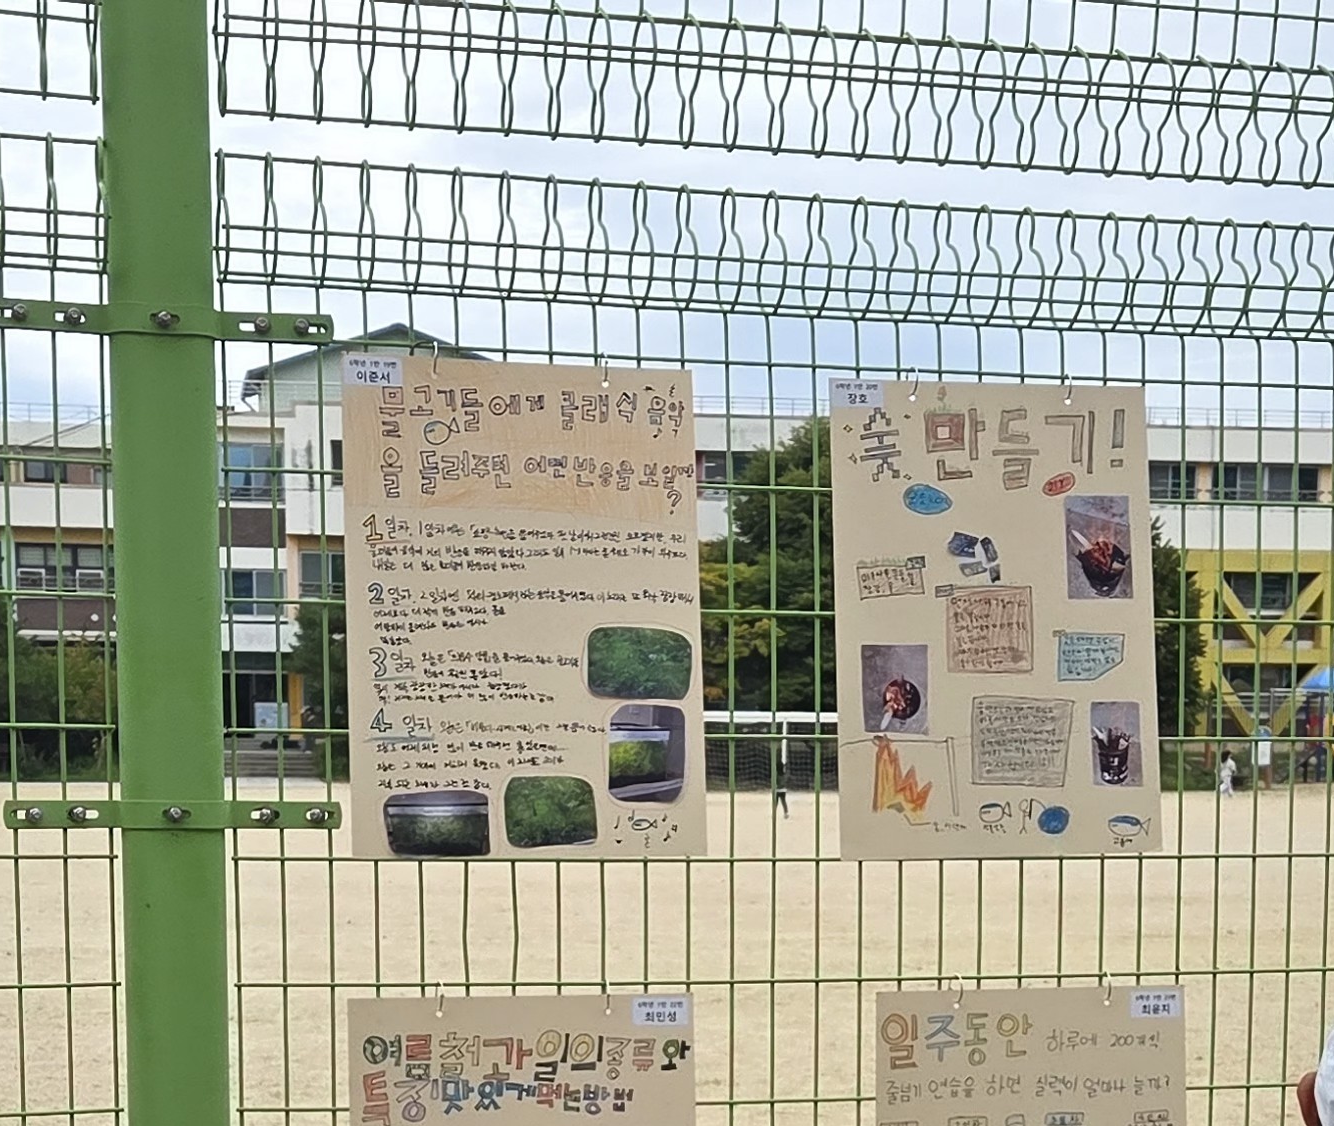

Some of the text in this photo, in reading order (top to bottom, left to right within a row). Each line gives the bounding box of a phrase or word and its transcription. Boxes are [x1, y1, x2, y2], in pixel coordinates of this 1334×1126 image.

[356, 370, 390, 384] 이준서
[562, 391, 637, 430] 클래식
[648, 395, 684, 429] 음악
[923, 408, 1125, 490] 만들기!
[381, 447, 403, 498] 을
[362, 514, 384, 541] 1
[368, 583, 384, 605] 2
[369, 648, 387, 678] 3
[370, 708, 393, 732] 4
[644, 1011, 677, 1023] 최민성
[362, 1032, 481, 1080] 여름철
[881, 1013, 1033, 1070] 일주동안
[1046, 1029, 1098, 1051] 하루에
[885, 1080, 922, 1105] 줄넘기
[928, 1075, 975, 1100] 연습을
[986, 1074, 1021, 1096] 하면
[1035, 1075, 1078, 1097] 실력이
[1083, 1077, 1126, 1098] 얼마나
